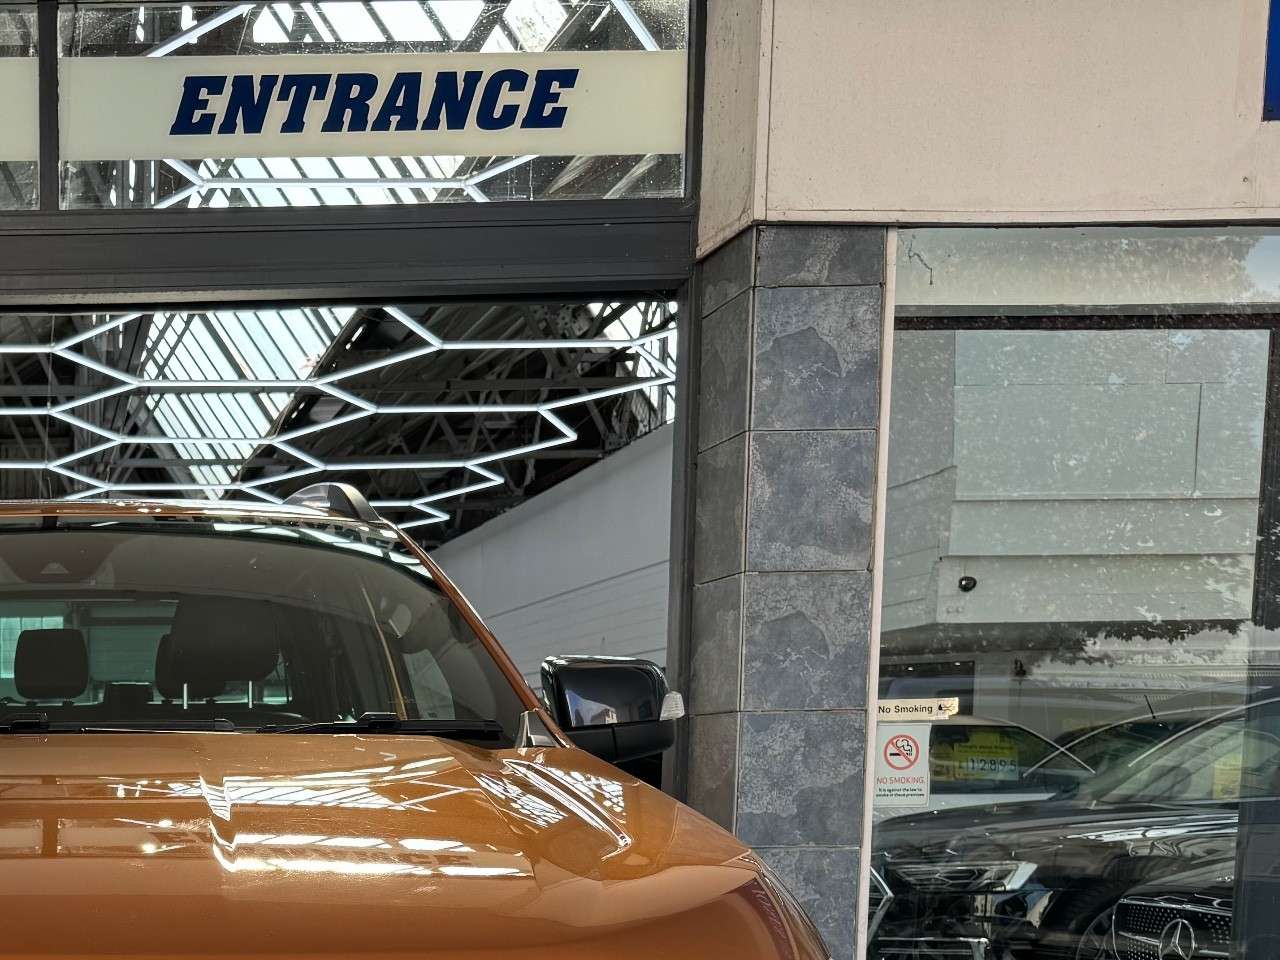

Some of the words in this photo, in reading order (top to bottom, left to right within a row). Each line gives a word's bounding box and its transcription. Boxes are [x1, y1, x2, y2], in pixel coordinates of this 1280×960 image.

[169, 69, 580, 136] ENTRANCE
[894, 705, 933, 714] Smoking
[876, 776, 888, 784] NO
